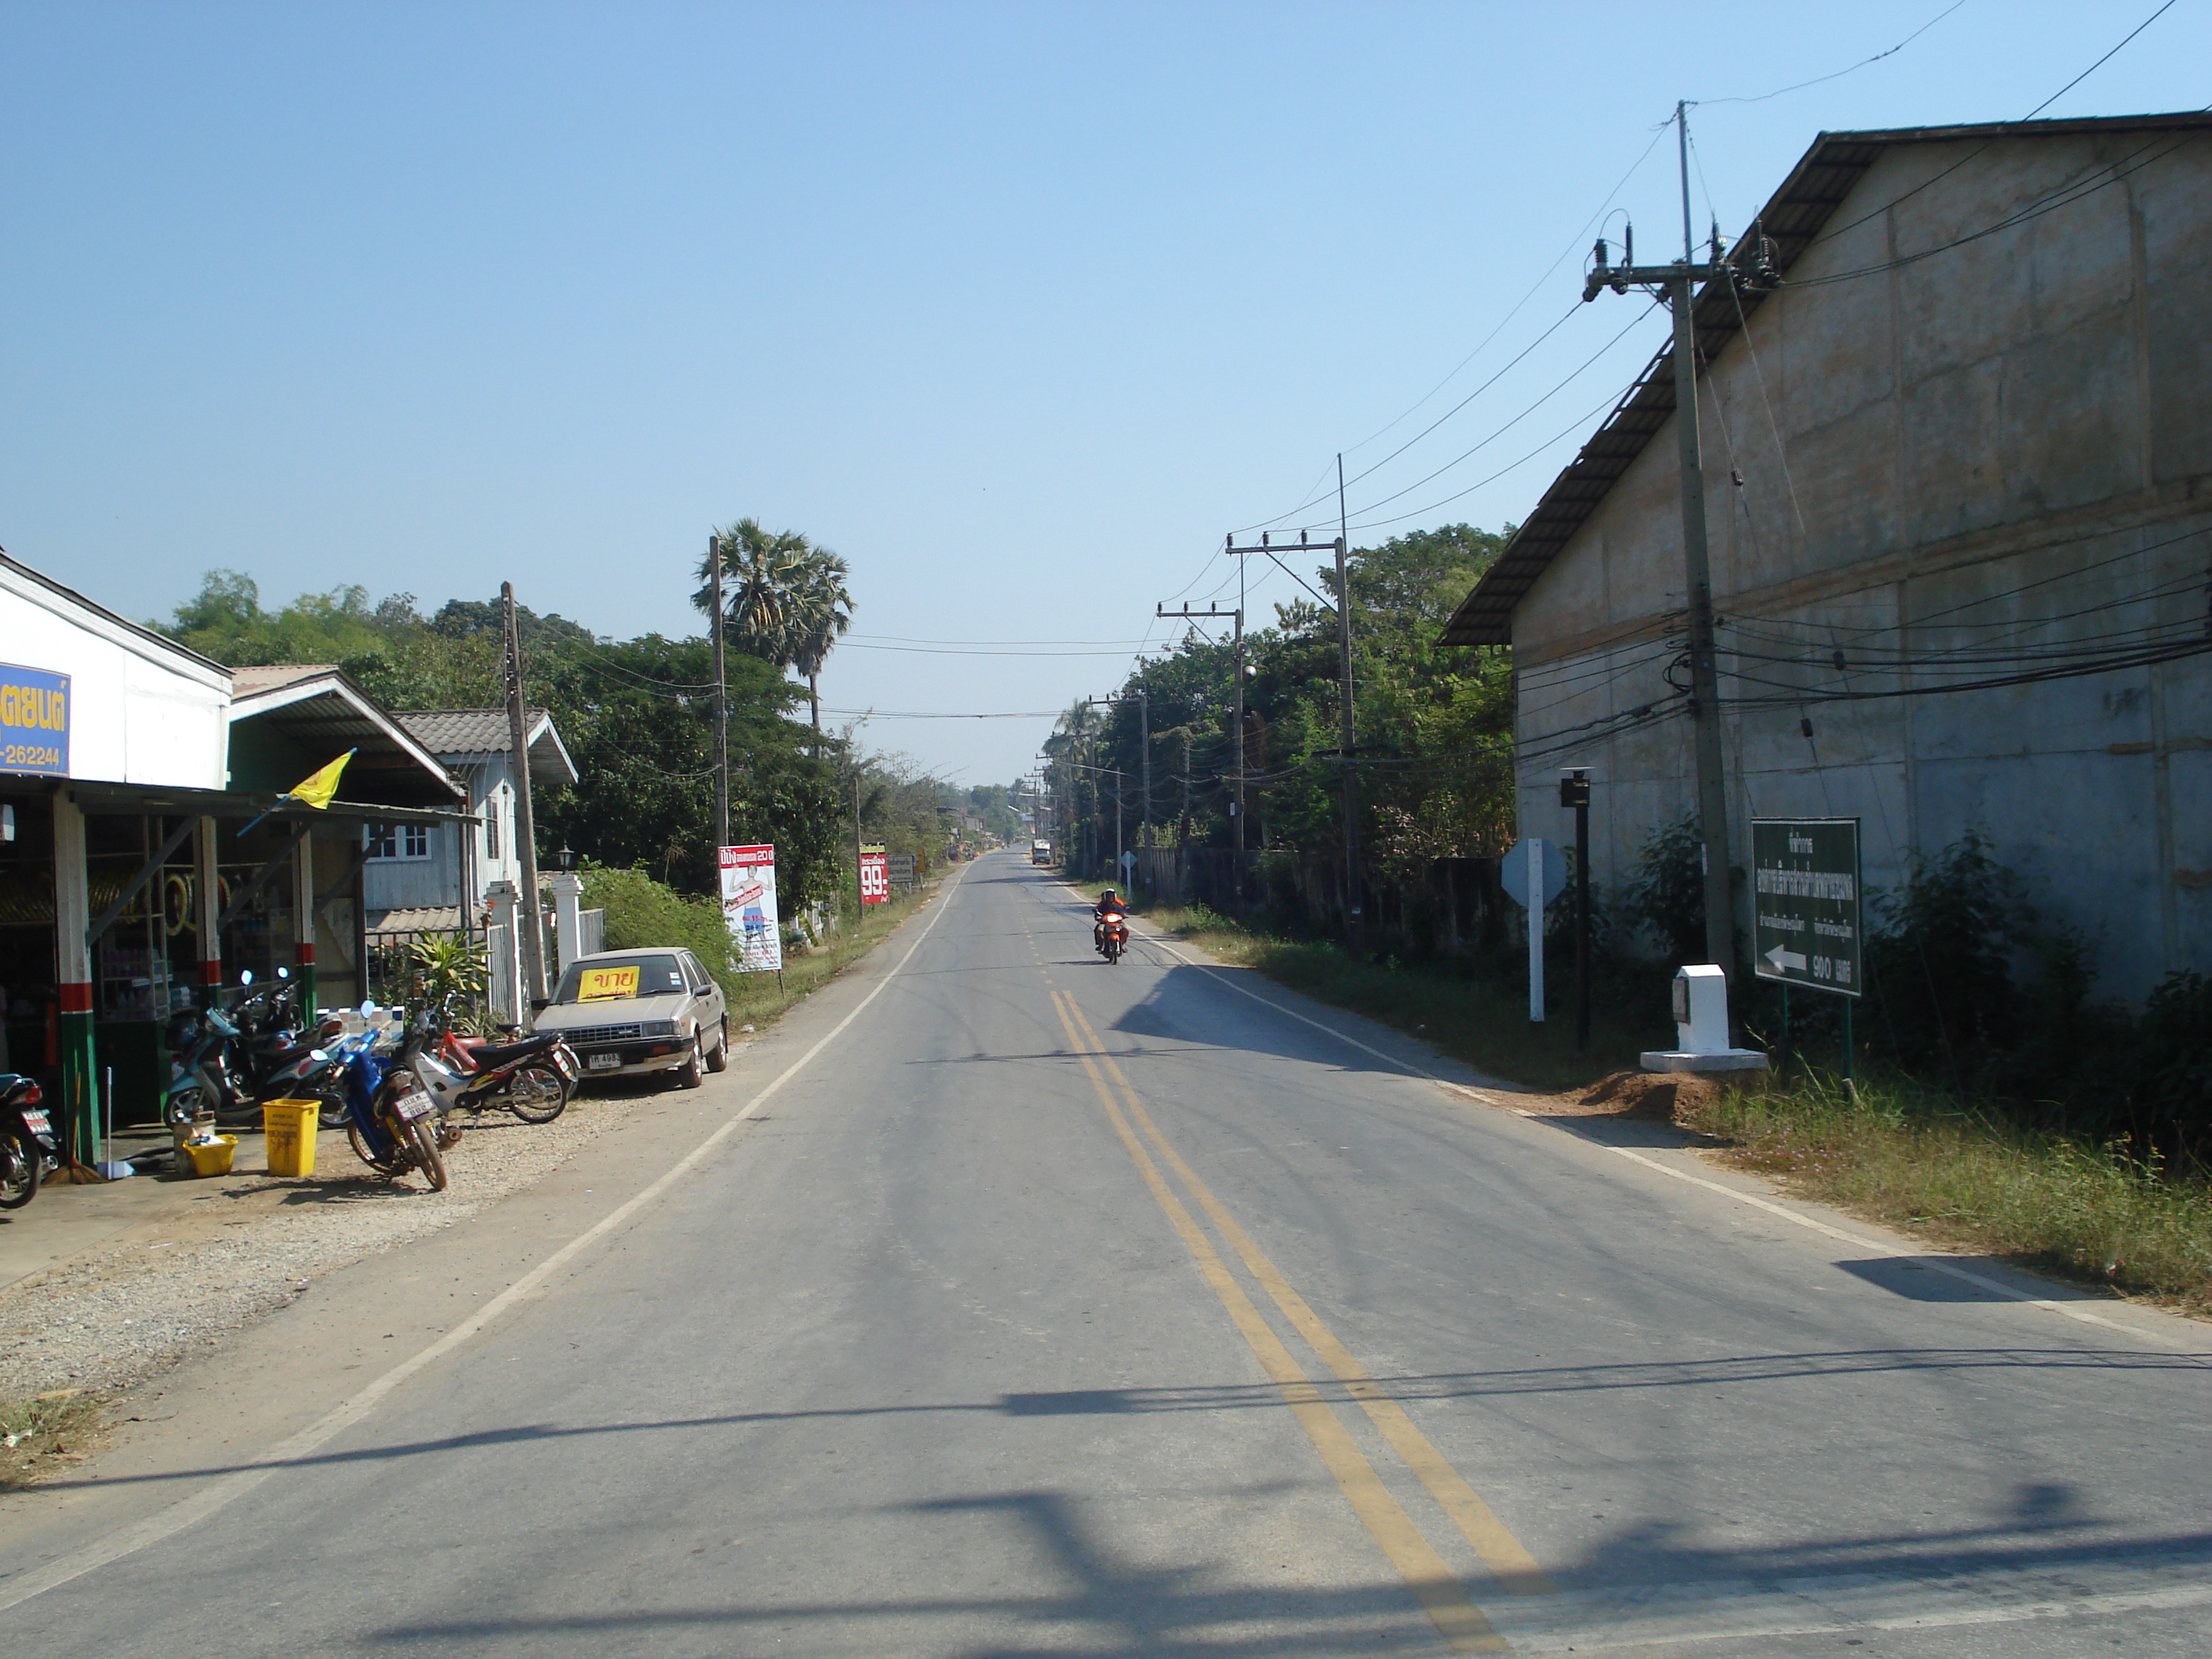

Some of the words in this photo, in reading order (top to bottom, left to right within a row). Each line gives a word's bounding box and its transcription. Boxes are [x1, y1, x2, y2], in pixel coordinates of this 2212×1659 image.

[0, 680, 65, 732] ตยนต์
[1813, 955, 1831, 979] 900
[594, 973, 634, 987] ขาย
